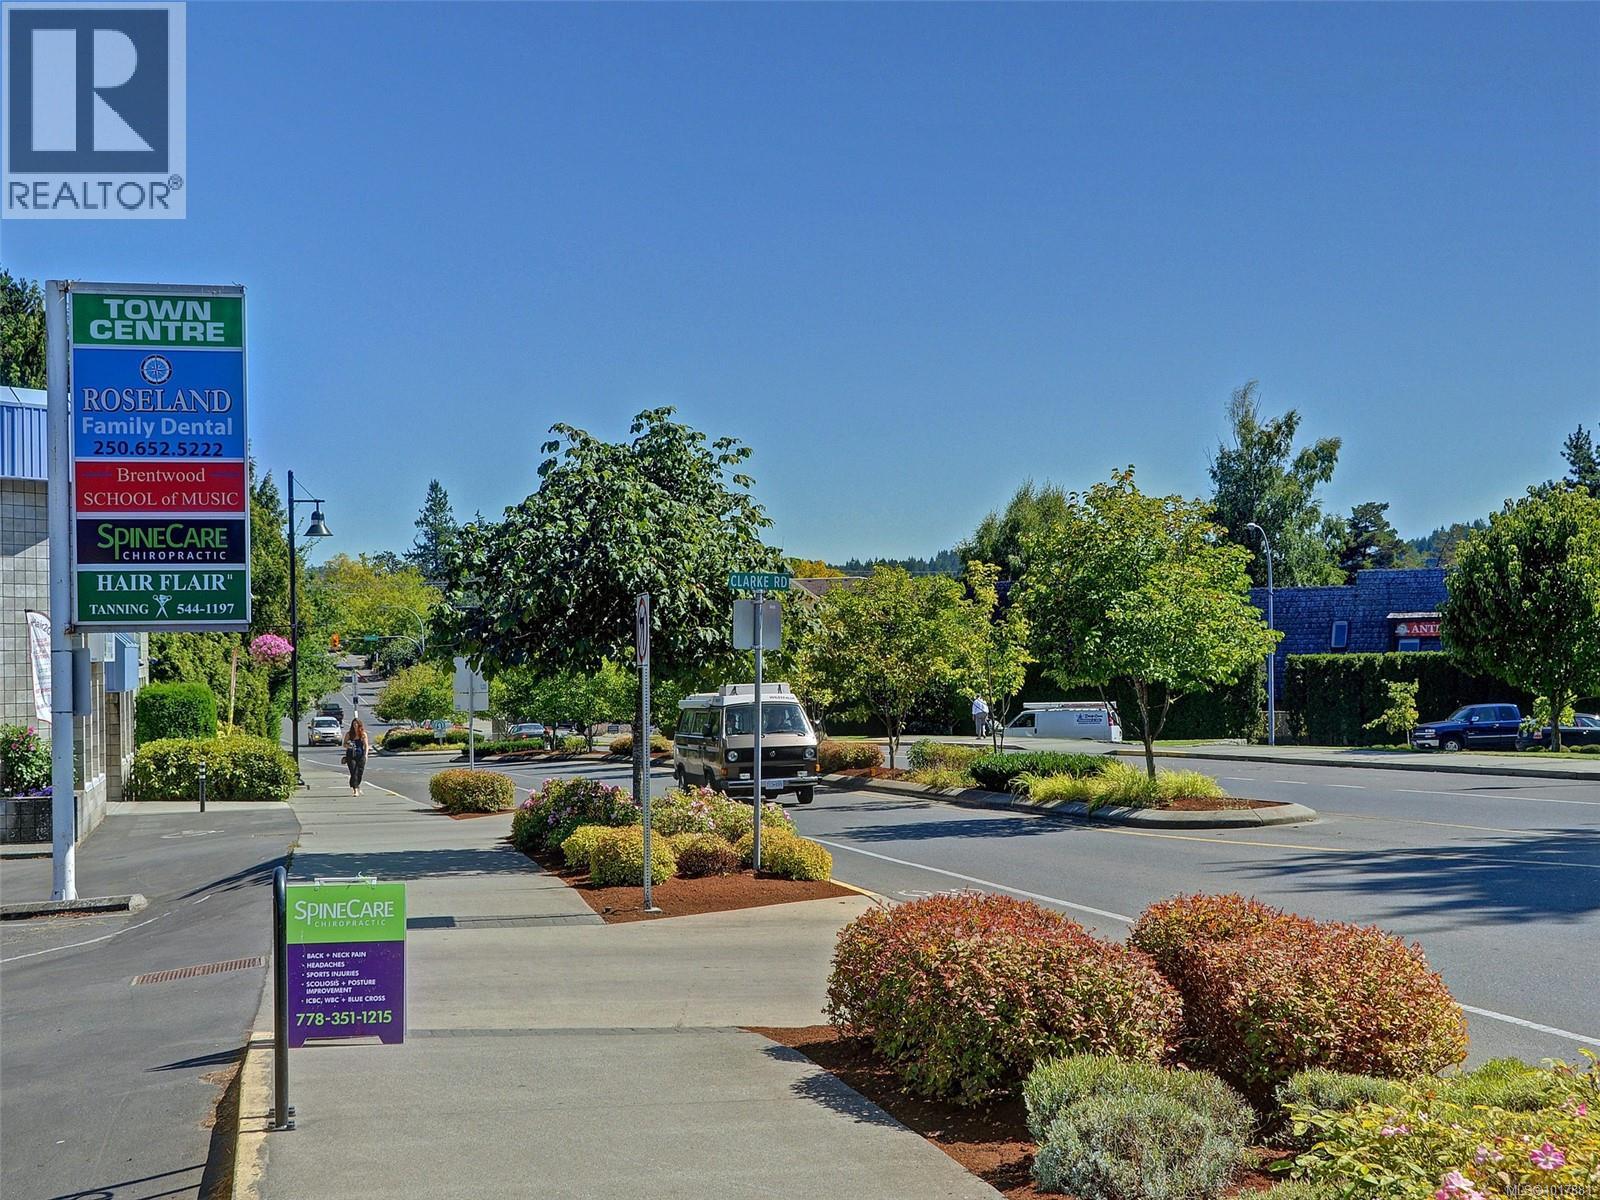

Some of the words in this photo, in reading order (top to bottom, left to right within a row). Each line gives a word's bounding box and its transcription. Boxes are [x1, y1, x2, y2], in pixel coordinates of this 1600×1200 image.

[103, 299, 211, 321] TOWN
[89, 319, 225, 342] CENTRE
[82, 388, 232, 414] ROSELAND
[82, 416, 156, 439] Family
[160, 417, 233, 436] Dental
[93, 441, 224, 457] 250.652.5222
[117, 467, 206, 483] Brentwood
[83, 492, 158, 506] SCHOOL
[161, 492, 178, 506] of
[181, 492, 239, 506] MUSIC
[122, 551, 227, 561] CHIROPRACTIC
[96, 574, 154, 592] HAIR
[730, 575, 769, 588] CLARKE
[773, 575, 788, 588] RD
[89, 604, 149, 615] TANNING
[176, 603, 235, 615] 544-1197
[314, 919, 387, 928] CHIROPRACTIC
[306, 961, 345, 969] HEADACHES
[306, 987, 352, 995] IMPROVEMENT
[295, 1010, 392, 1026] 778-351-1215
